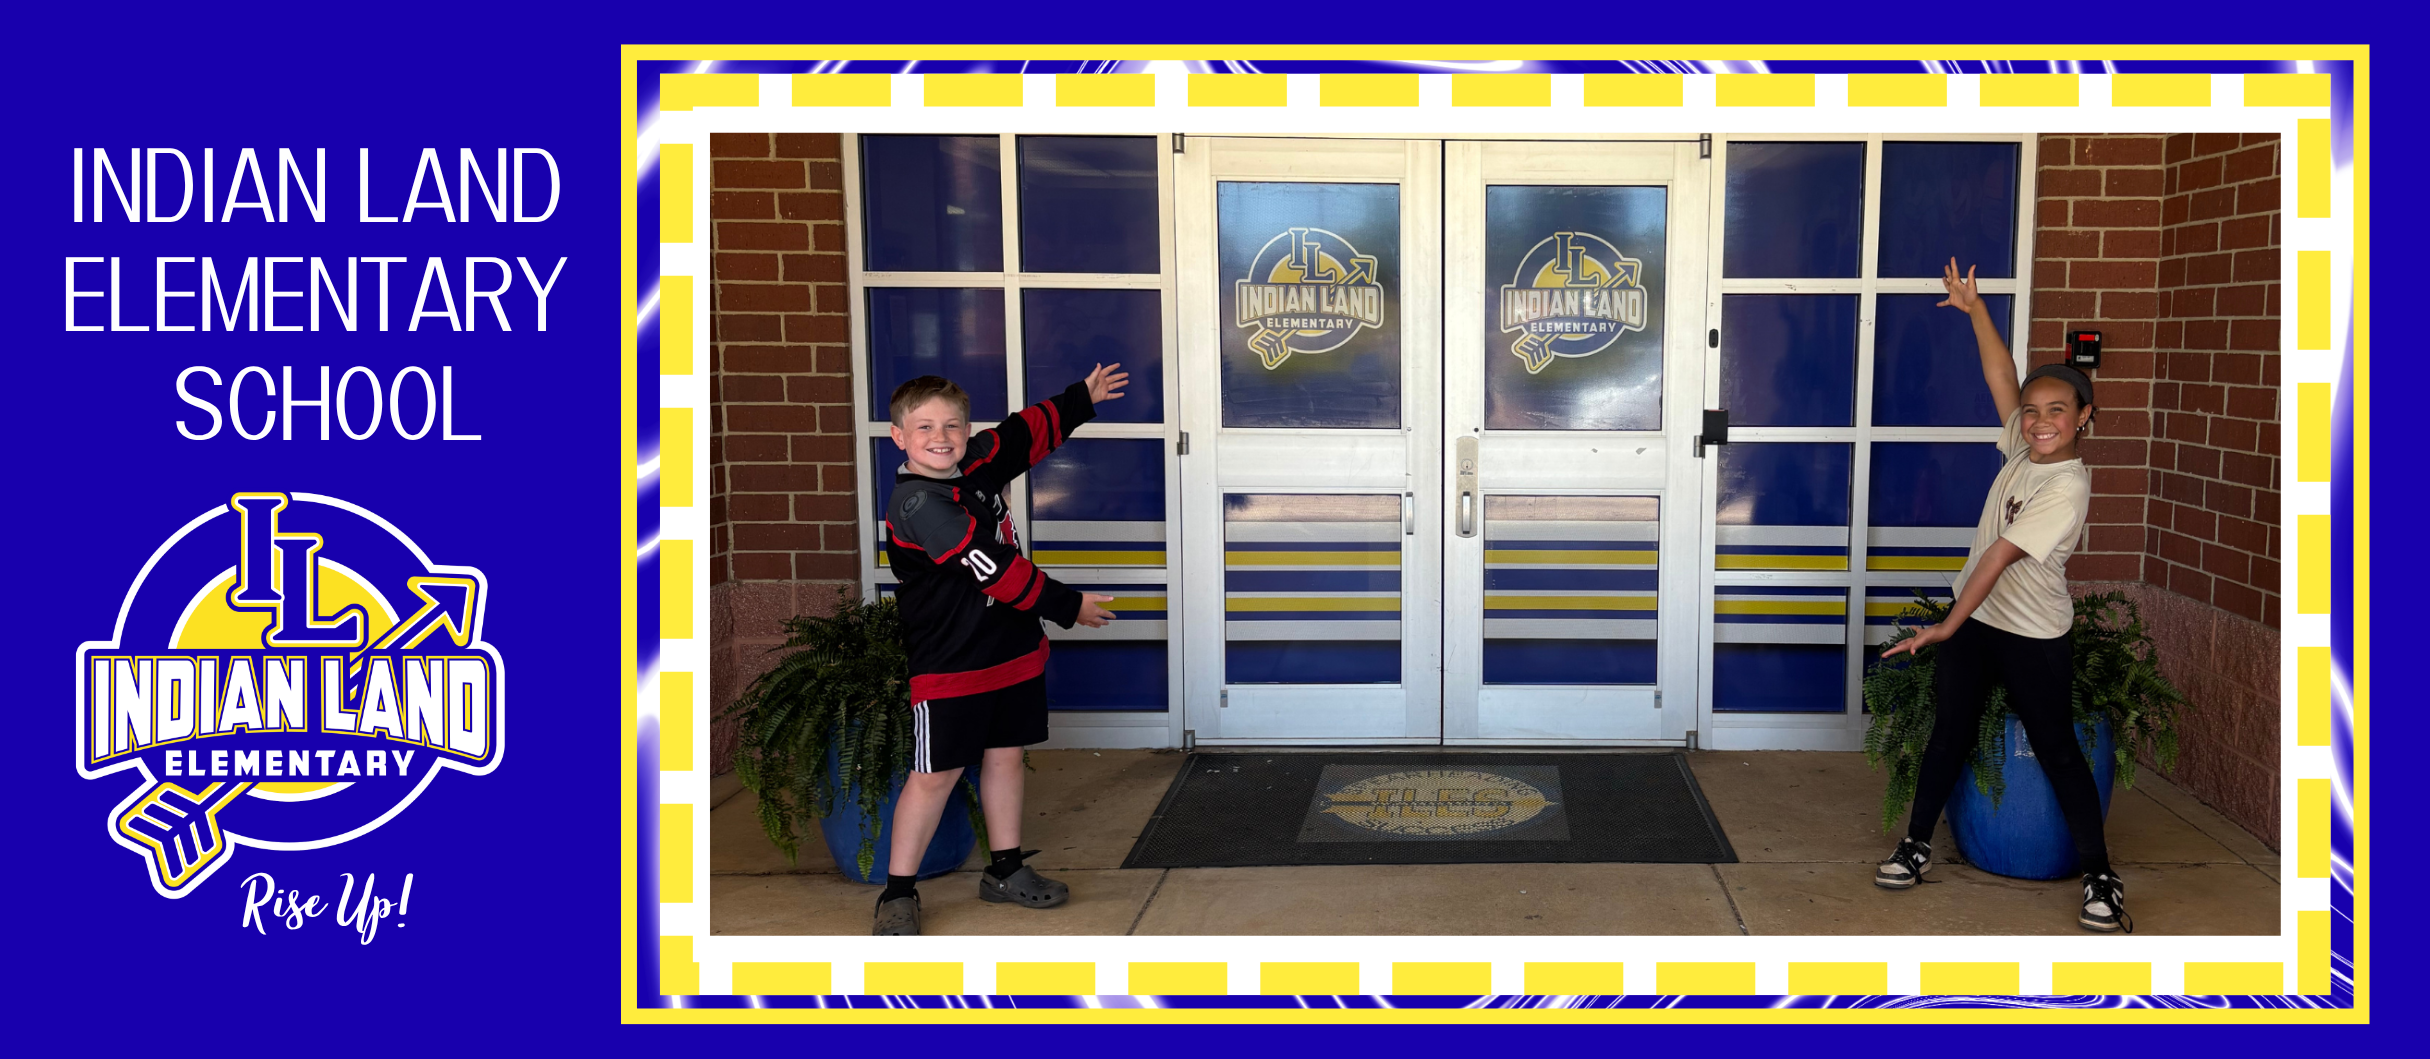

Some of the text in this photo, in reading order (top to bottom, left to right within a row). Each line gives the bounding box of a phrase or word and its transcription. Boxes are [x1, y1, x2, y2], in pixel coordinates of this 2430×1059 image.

[1288, 227, 1336, 284] IL
[1553, 231, 1601, 288] IL
[1240, 285, 1380, 324] INDIAN LAND
[1505, 289, 1643, 328] INDIAN LAND
[1266, 317, 1354, 329] ELEMENTARY
[1530, 322, 1617, 333] ELEMENTARY
[961, 549, 998, 582] 20
[1367, 787, 1511, 818] ILES
